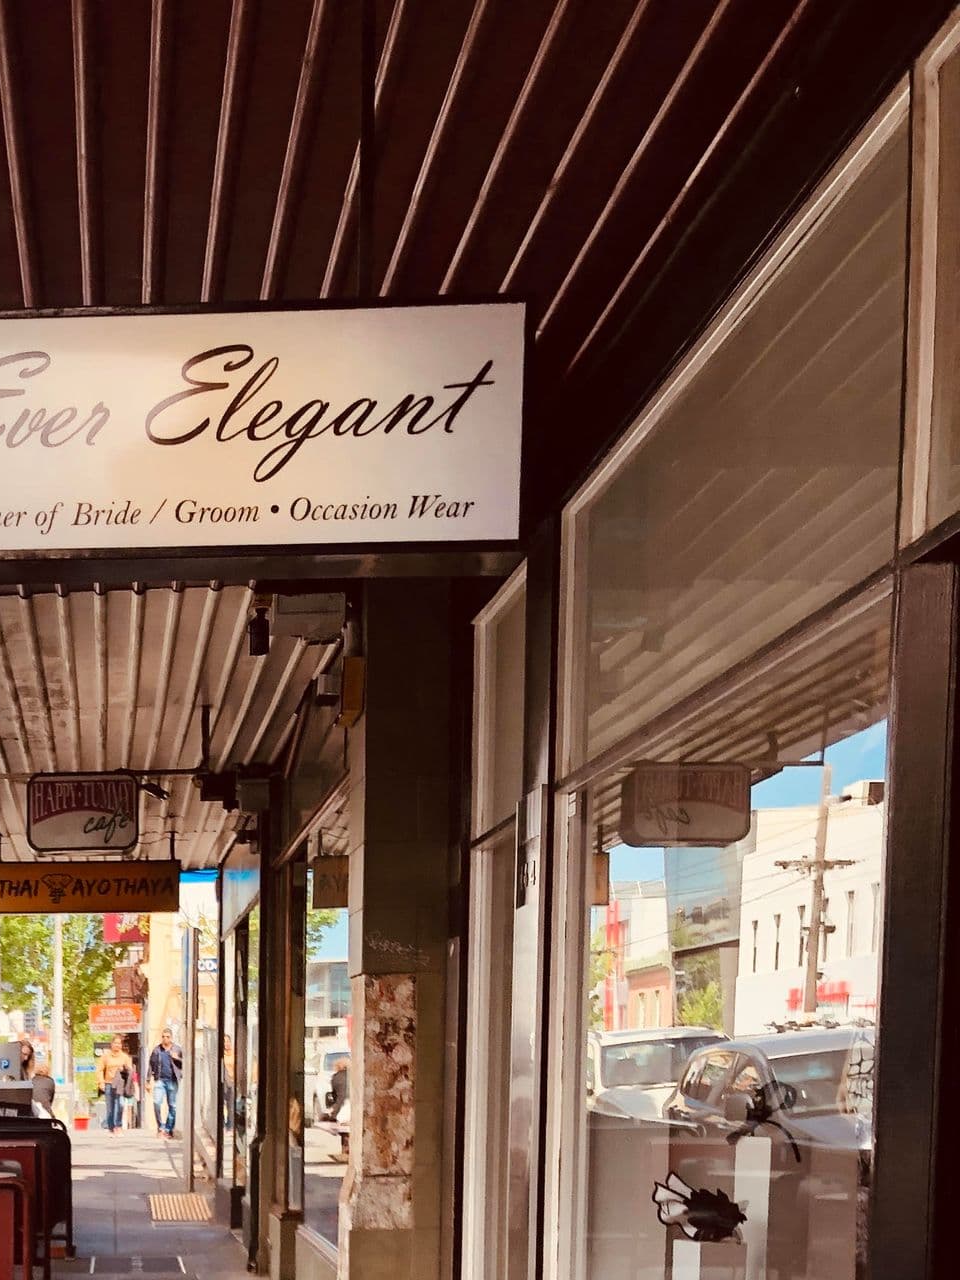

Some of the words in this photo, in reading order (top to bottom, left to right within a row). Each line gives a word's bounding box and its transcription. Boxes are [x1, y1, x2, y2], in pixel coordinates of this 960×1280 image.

[145, 344, 495, 483] Elegant
[34, 501, 64, 535] of
[71, 500, 142, 526] Bride
[174, 499, 260, 524] Groom
[290, 495, 398, 522] Occasion
[407, 494, 475, 519] Wear
[34, 782, 78, 819] HAPPY
[71, 877, 174, 897] AYOTHAYA
